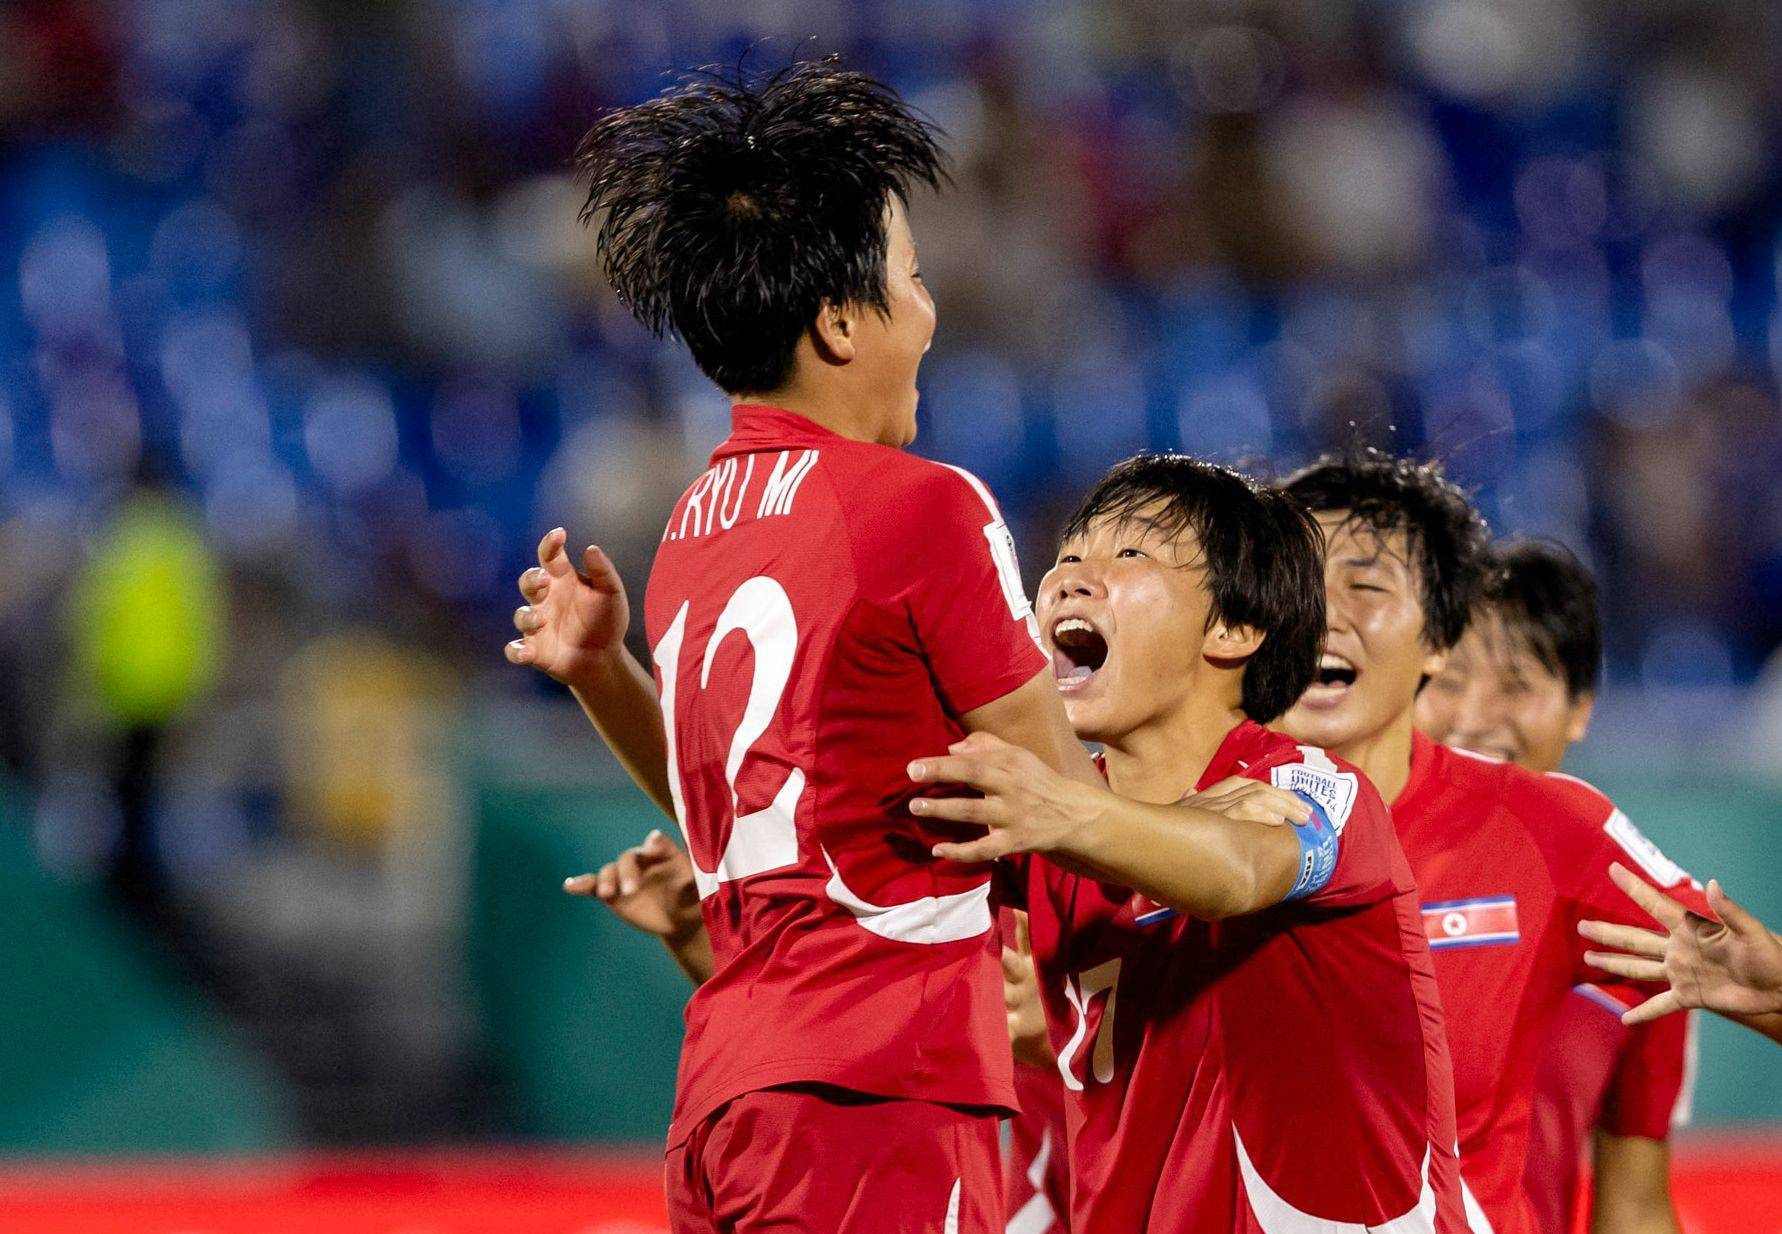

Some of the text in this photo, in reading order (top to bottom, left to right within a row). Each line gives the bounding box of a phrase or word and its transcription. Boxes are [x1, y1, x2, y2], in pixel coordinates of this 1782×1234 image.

[662, 449, 820, 542] .RYU MI
[653, 575, 806, 900] 12
[1291, 769, 1336, 790] FOOTBALL
[1291, 775, 1337, 800] UNITES
[1057, 957, 1122, 1091] 17
